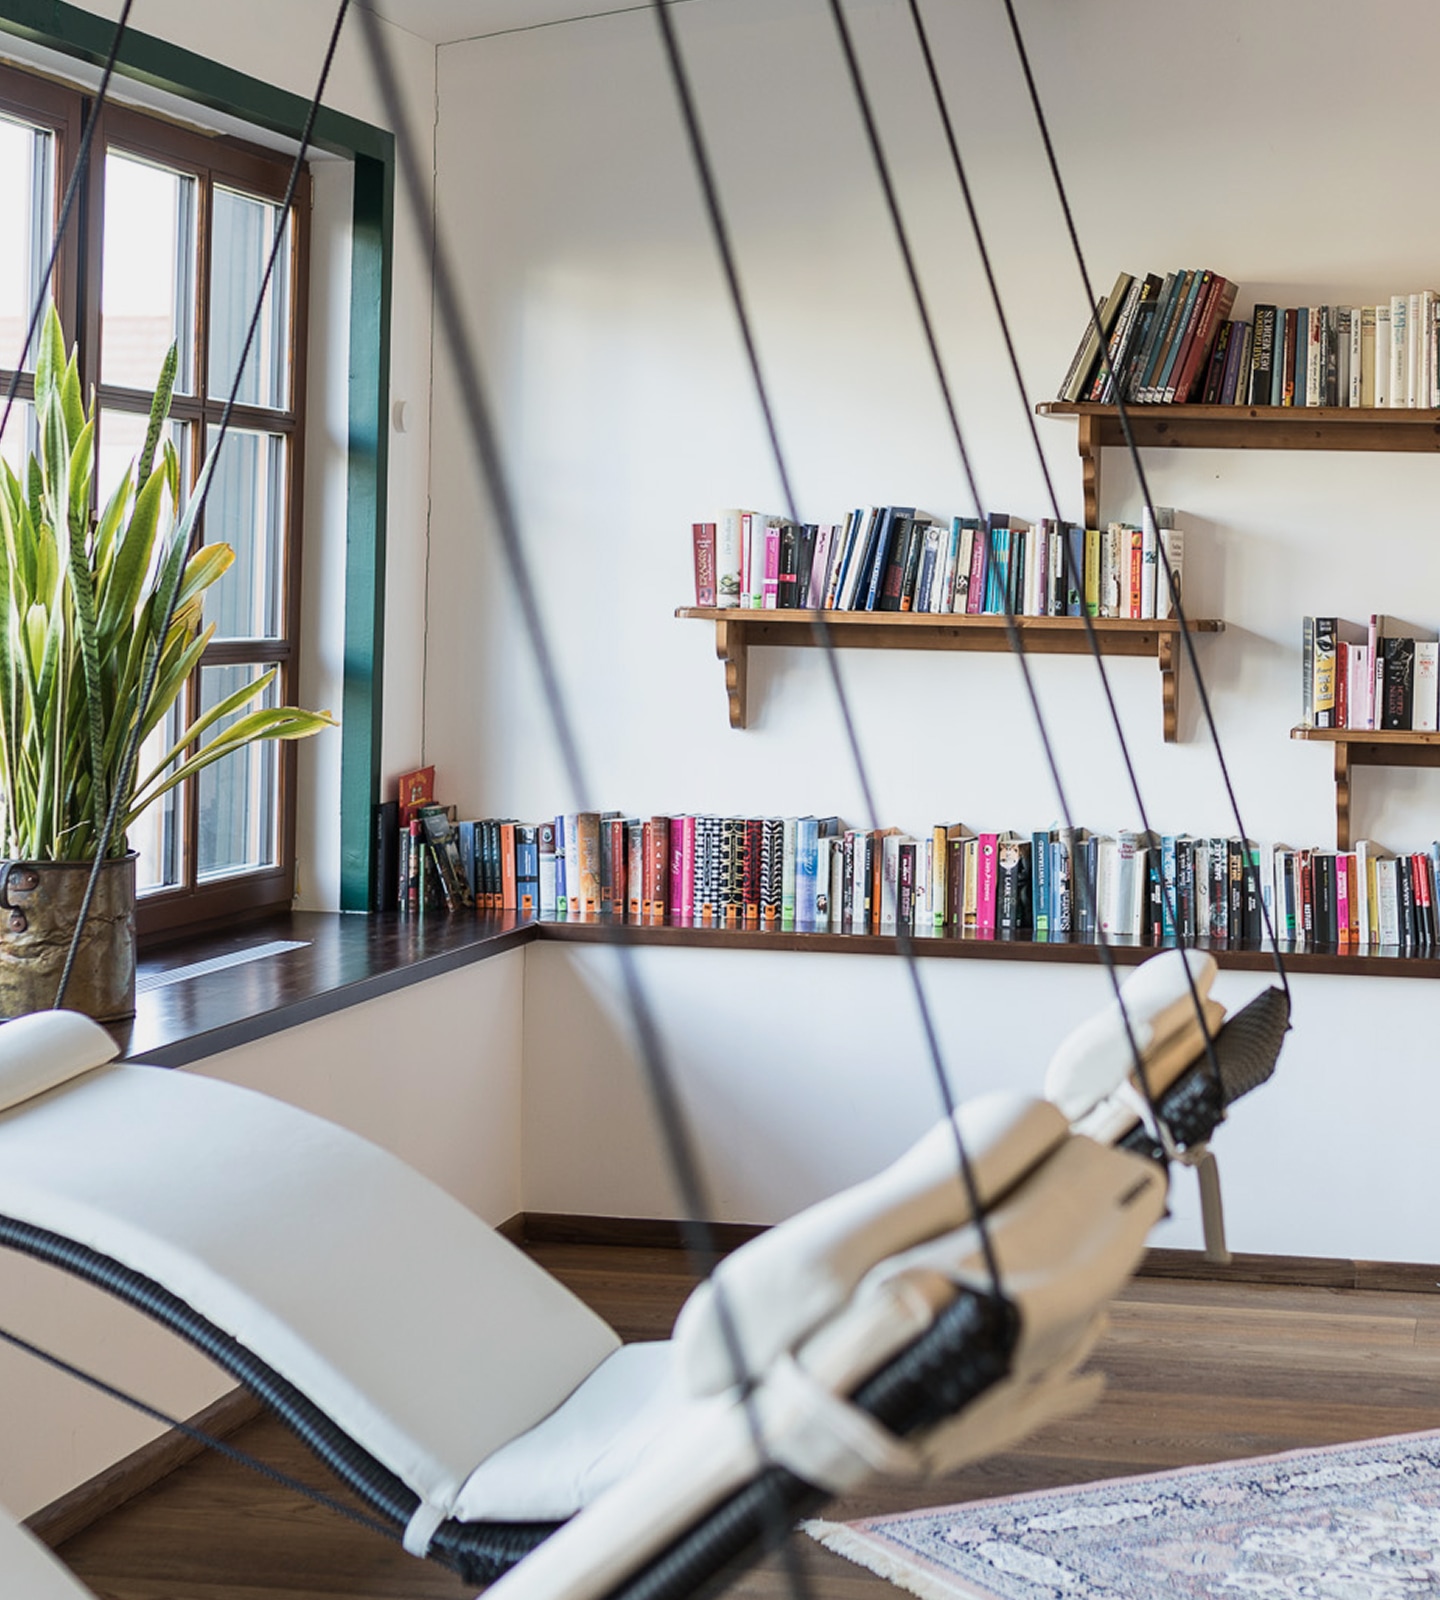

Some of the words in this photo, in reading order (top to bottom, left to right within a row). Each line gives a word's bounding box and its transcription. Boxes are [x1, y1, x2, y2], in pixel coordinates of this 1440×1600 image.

[1255, 310, 1264, 346] GORDON
[1262, 310, 1273, 350] MEDICUS
[1253, 347, 1262, 370] NOAH
[1260, 352, 1270, 371] DER
[1389, 685, 1397, 714] TOTEN
